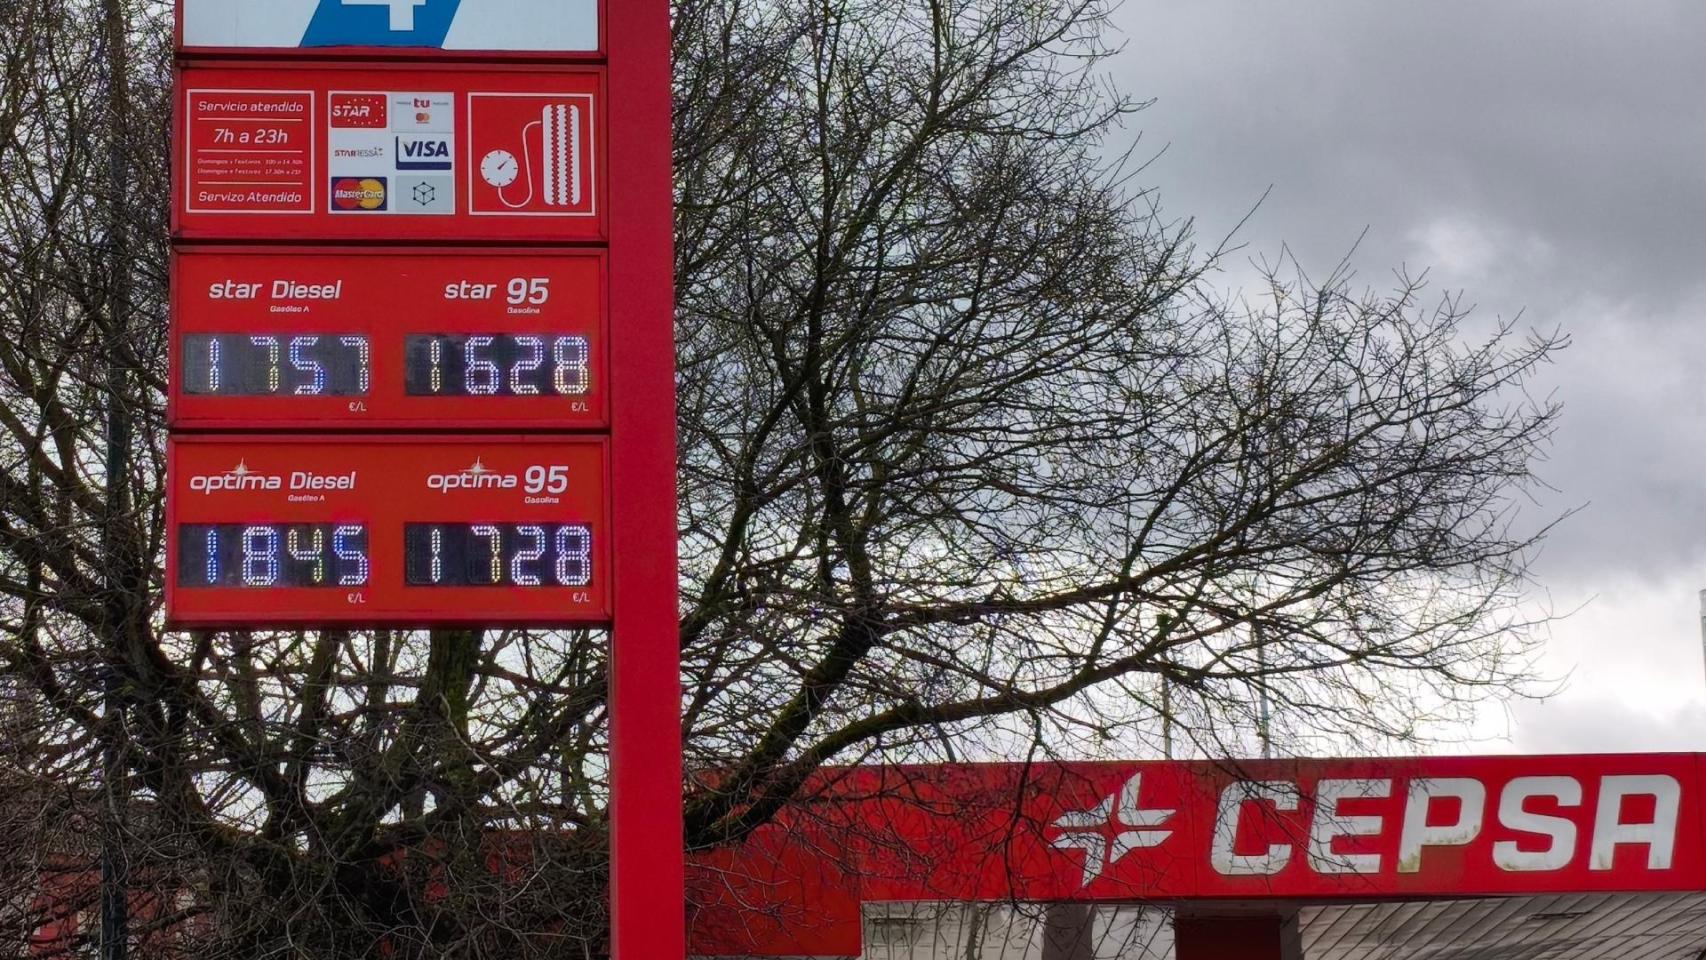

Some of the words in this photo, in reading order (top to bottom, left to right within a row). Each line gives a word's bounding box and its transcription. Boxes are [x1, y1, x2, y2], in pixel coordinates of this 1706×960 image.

[198, 101, 248, 111] Servicio
[250, 101, 304, 112] atendido
[413, 98, 431, 108] tu
[332, 105, 371, 117] STAR
[214, 128, 234, 143] 7h
[239, 132, 250, 143] a
[254, 129, 288, 143] 23h
[403, 141, 449, 157] VISA
[198, 191, 245, 202] Servizo
[246, 191, 302, 203] Atendido
[335, 189, 384, 199] MasterCard
[208, 279, 263, 299] star
[271, 279, 342, 299] Diesel
[444, 279, 497, 299] star
[506, 277, 550, 304] 95
[507, 306, 540, 314] Gasolina
[209, 336, 368, 395] 1757
[431, 336, 588, 395] 1628
[348, 401, 367, 412] €/L
[571, 401, 589, 412] €/L
[189, 473, 282, 495] optima
[289, 471, 357, 490] Diesel
[427, 472, 518, 494] optima
[524, 465, 569, 494] 95
[524, 496, 560, 504] Gasolina
[207, 525, 368, 585] 1845
[431, 525, 590, 585] 1728
[347, 593, 366, 604] €/L
[572, 592, 590, 603] €/L
[1210, 774, 1682, 875] CEPSA
